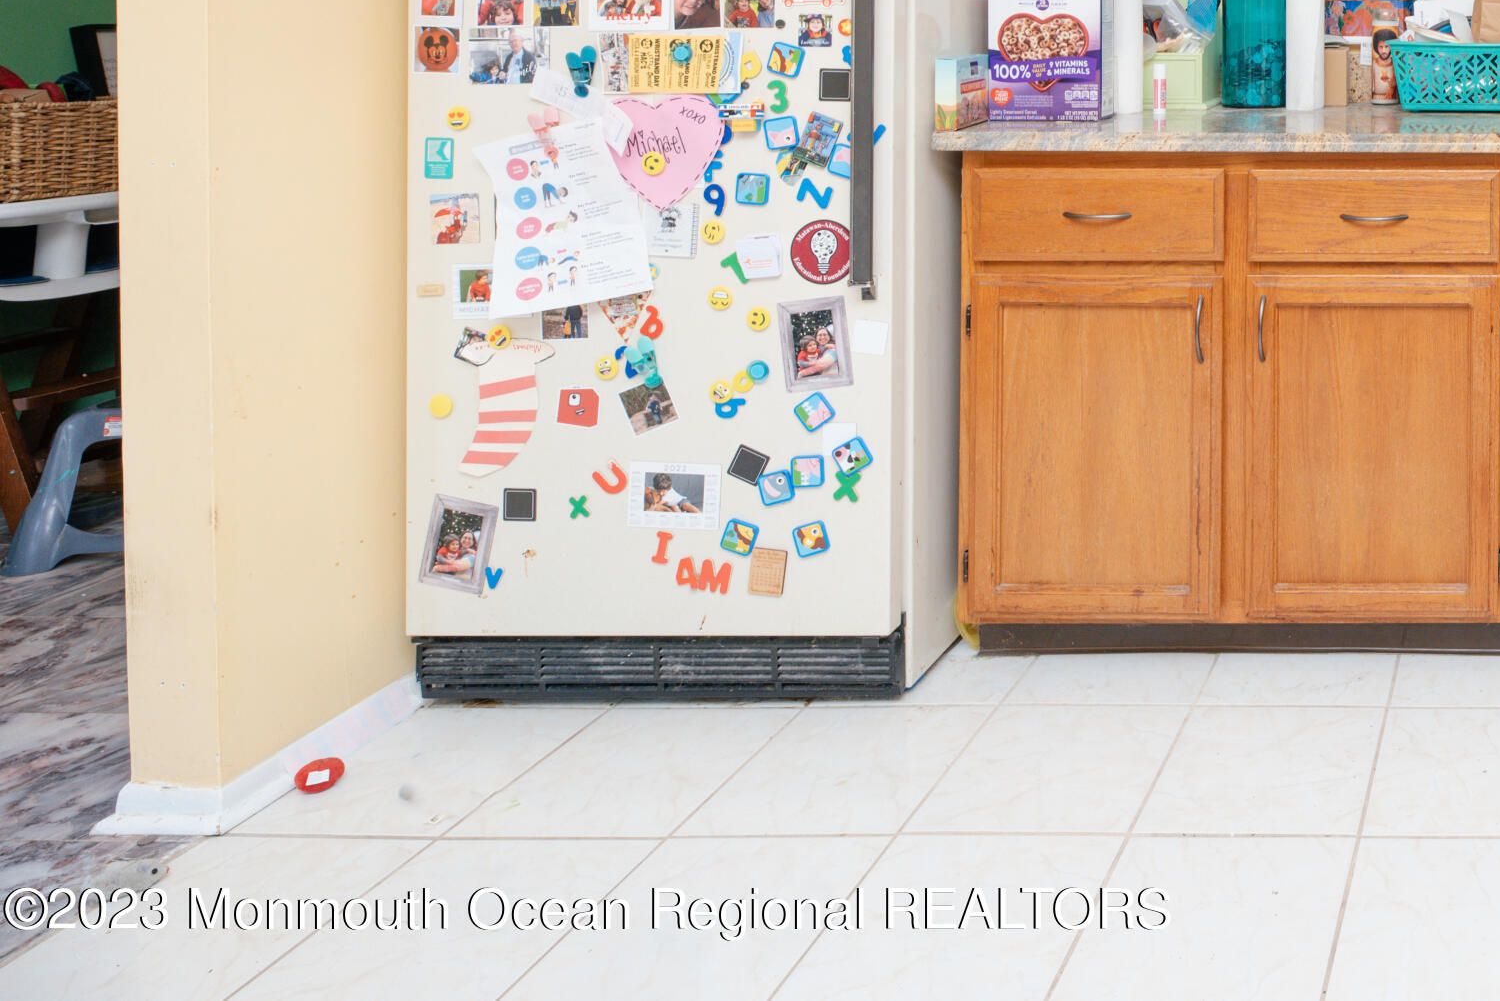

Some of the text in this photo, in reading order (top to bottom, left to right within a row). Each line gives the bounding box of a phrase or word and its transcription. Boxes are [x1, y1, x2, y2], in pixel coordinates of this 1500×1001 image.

[606, 12, 651, 24] merry
[711, 39, 720, 75] WRISTBAND
[1055, 60, 1088, 68] VITAMINS
[993, 63, 1031, 79] 100%
[1053, 67, 1090, 76] MINERALS
[767, 80, 789, 113] 3
[626, 126, 687, 164] Michael
